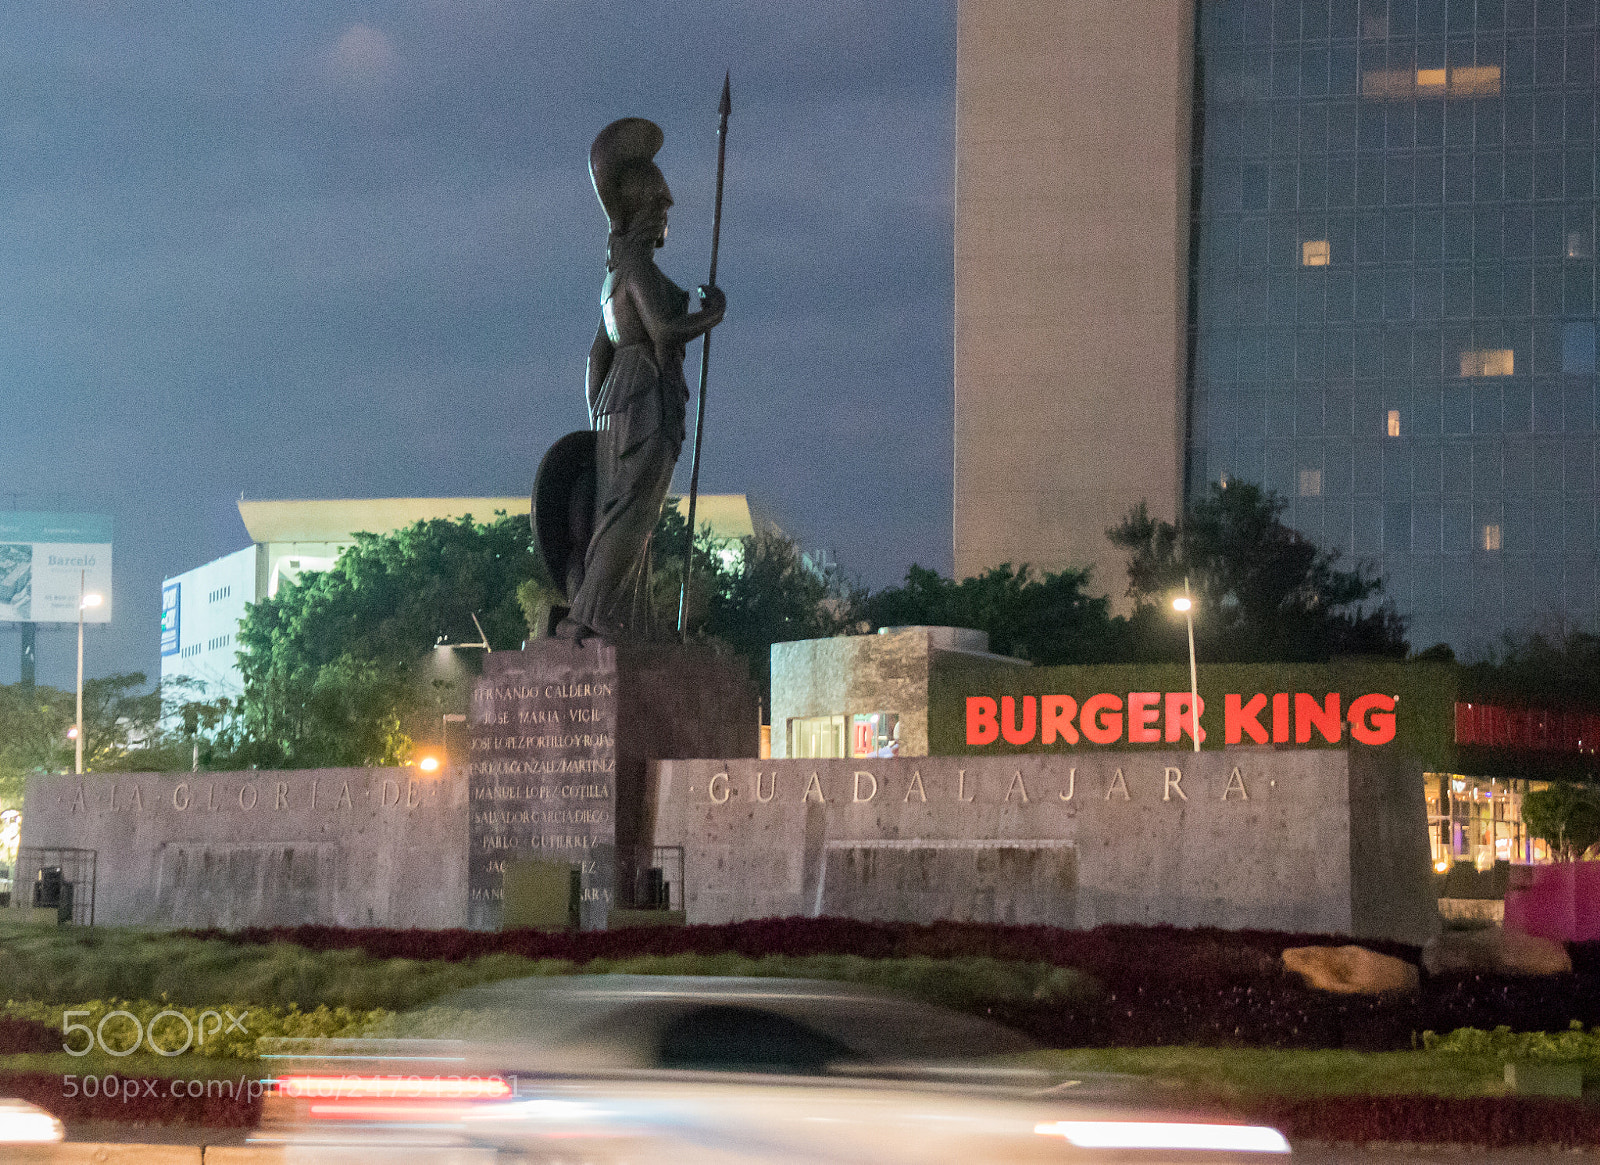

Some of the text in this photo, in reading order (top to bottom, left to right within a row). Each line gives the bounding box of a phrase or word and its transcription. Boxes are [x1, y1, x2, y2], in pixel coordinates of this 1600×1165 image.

[48, 555, 96, 567] Barceló
[474, 684, 611, 700] FERNANDO CALDERON
[484, 708, 601, 724] JOSE MARIA VIGIL
[964, 692, 1399, 746] BURGER KING
[475, 785, 520, 800] MANUEL
[561, 784, 609, 799] COTILLA
[708, 766, 1251, 803] GUADALAJARA
[71, 779, 421, 813] A LA GLORIA DE
[482, 835, 519, 849] PABLO
